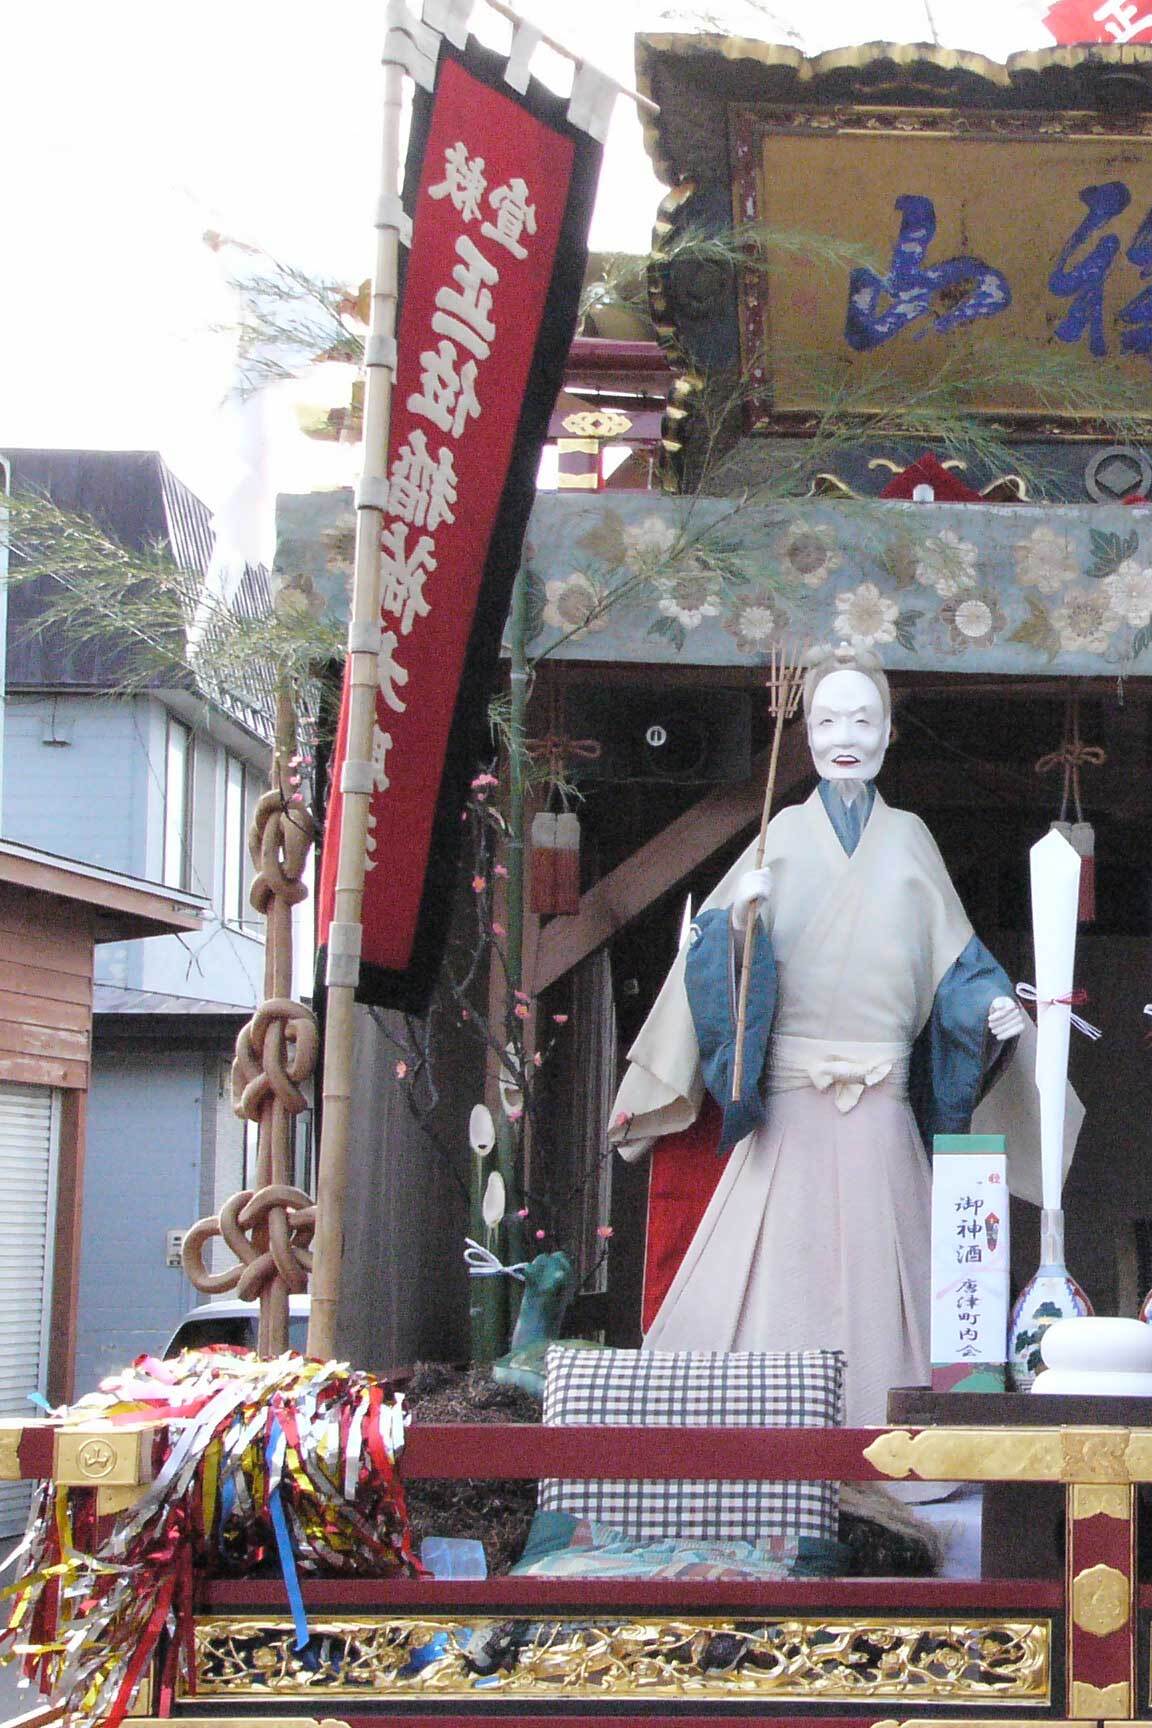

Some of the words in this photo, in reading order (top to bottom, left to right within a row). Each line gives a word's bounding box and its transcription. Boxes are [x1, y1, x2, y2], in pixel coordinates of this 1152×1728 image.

[954, 1195, 984, 1265] 御神酒
[955, 1278, 983, 1357] 唐津町内会
